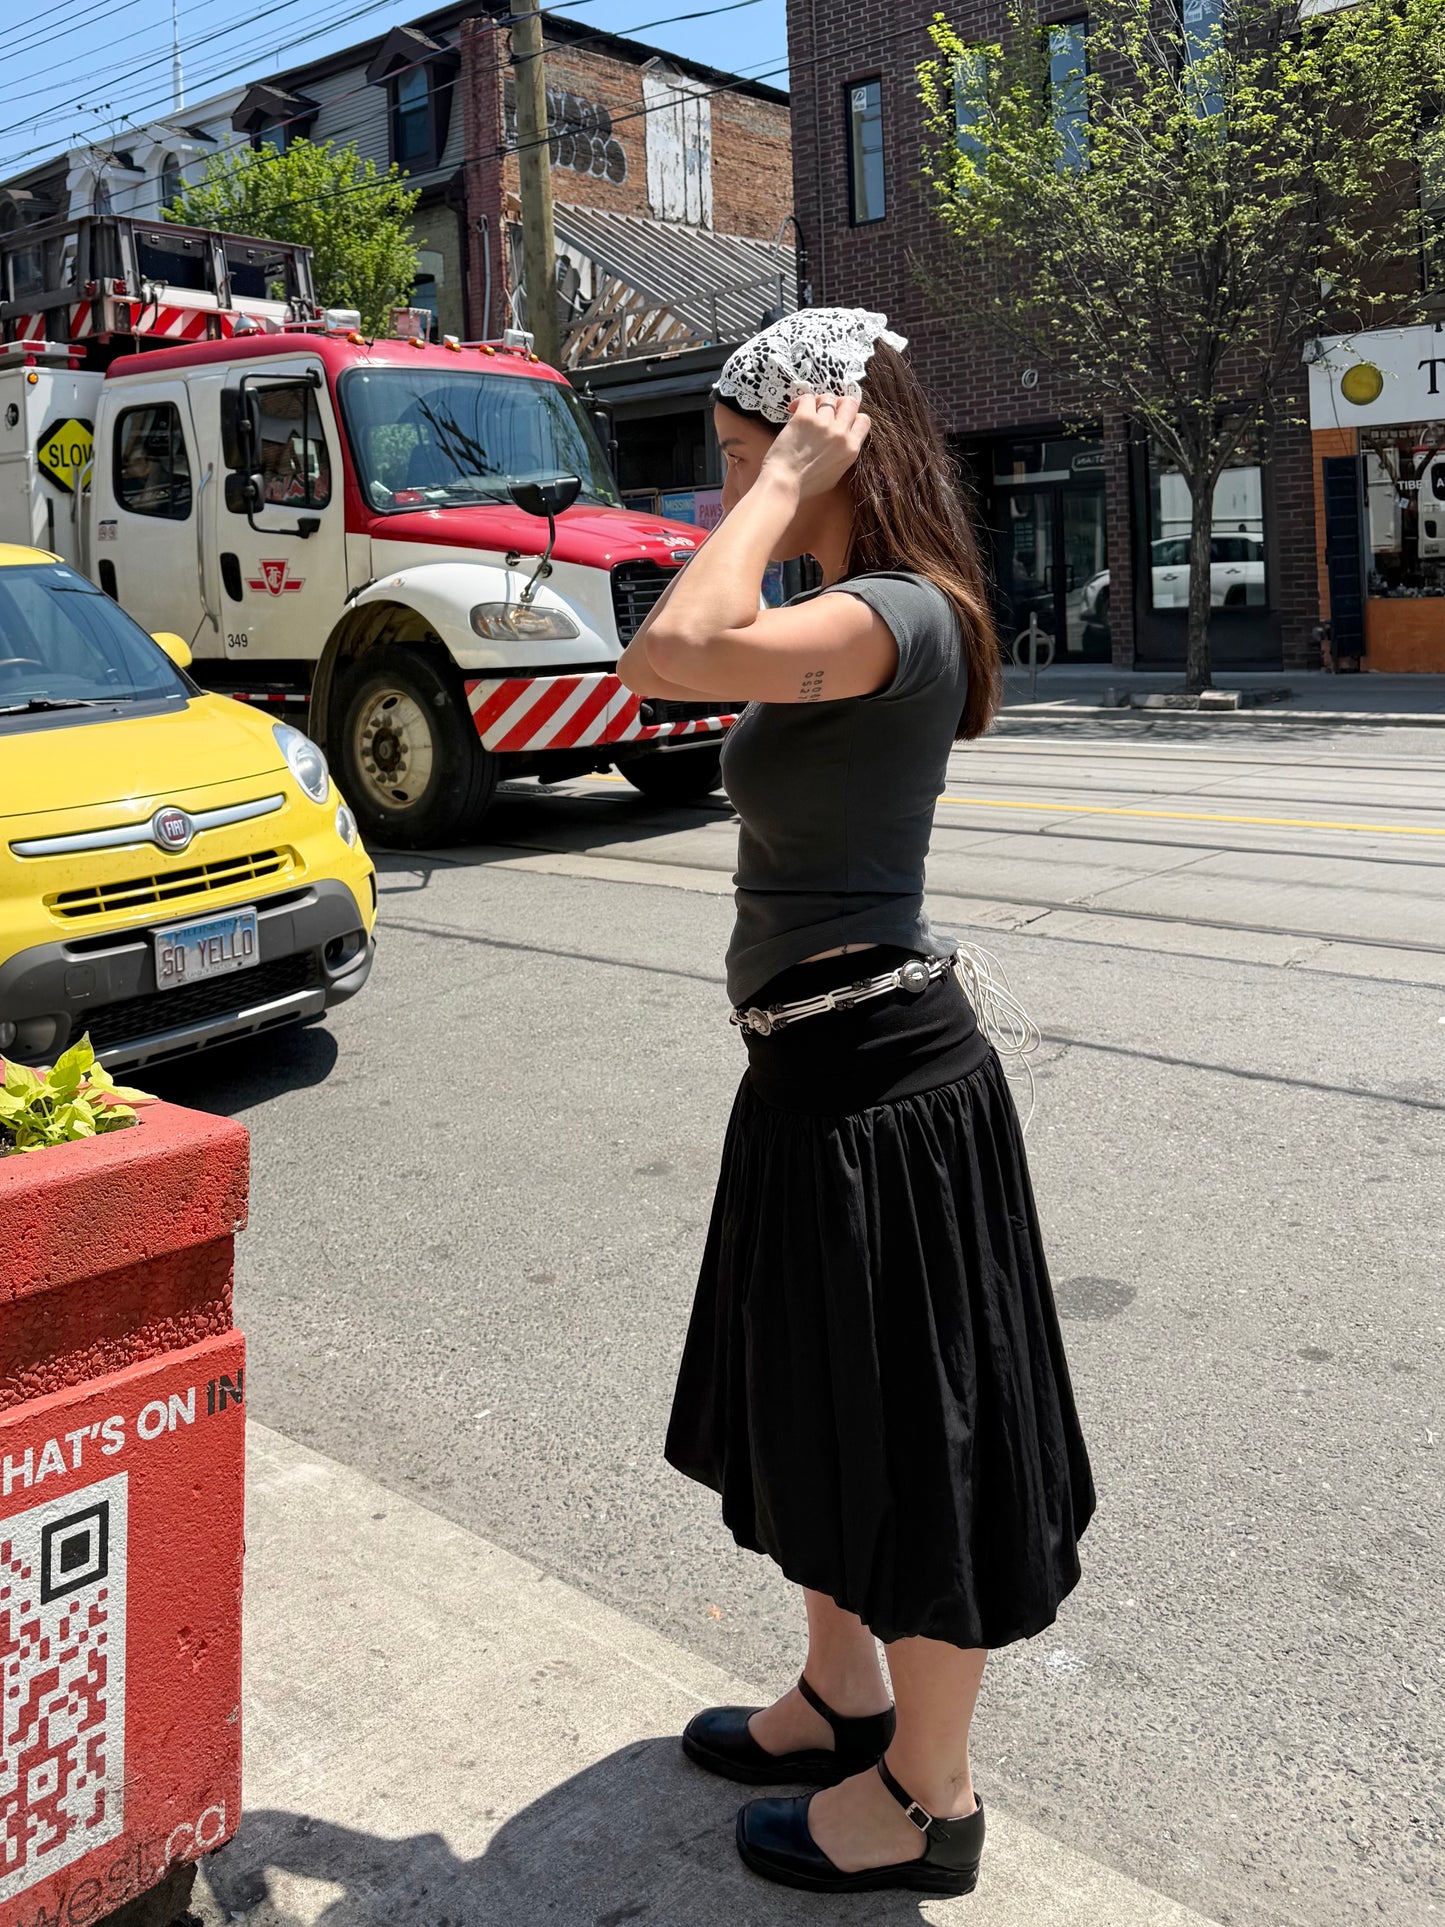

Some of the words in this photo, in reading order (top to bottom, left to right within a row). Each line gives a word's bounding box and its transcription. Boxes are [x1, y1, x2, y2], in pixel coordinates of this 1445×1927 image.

[699, 503, 722, 518] PAWS
[656, 536, 696, 547] 349
[227, 633, 249, 648] 349
[165, 819, 185, 837] FIAT
[163, 946, 185, 976] SO
[197, 929, 253, 967] YELLO
[137, 1386, 196, 1440] ON
[206, 1369, 243, 1416] IN
